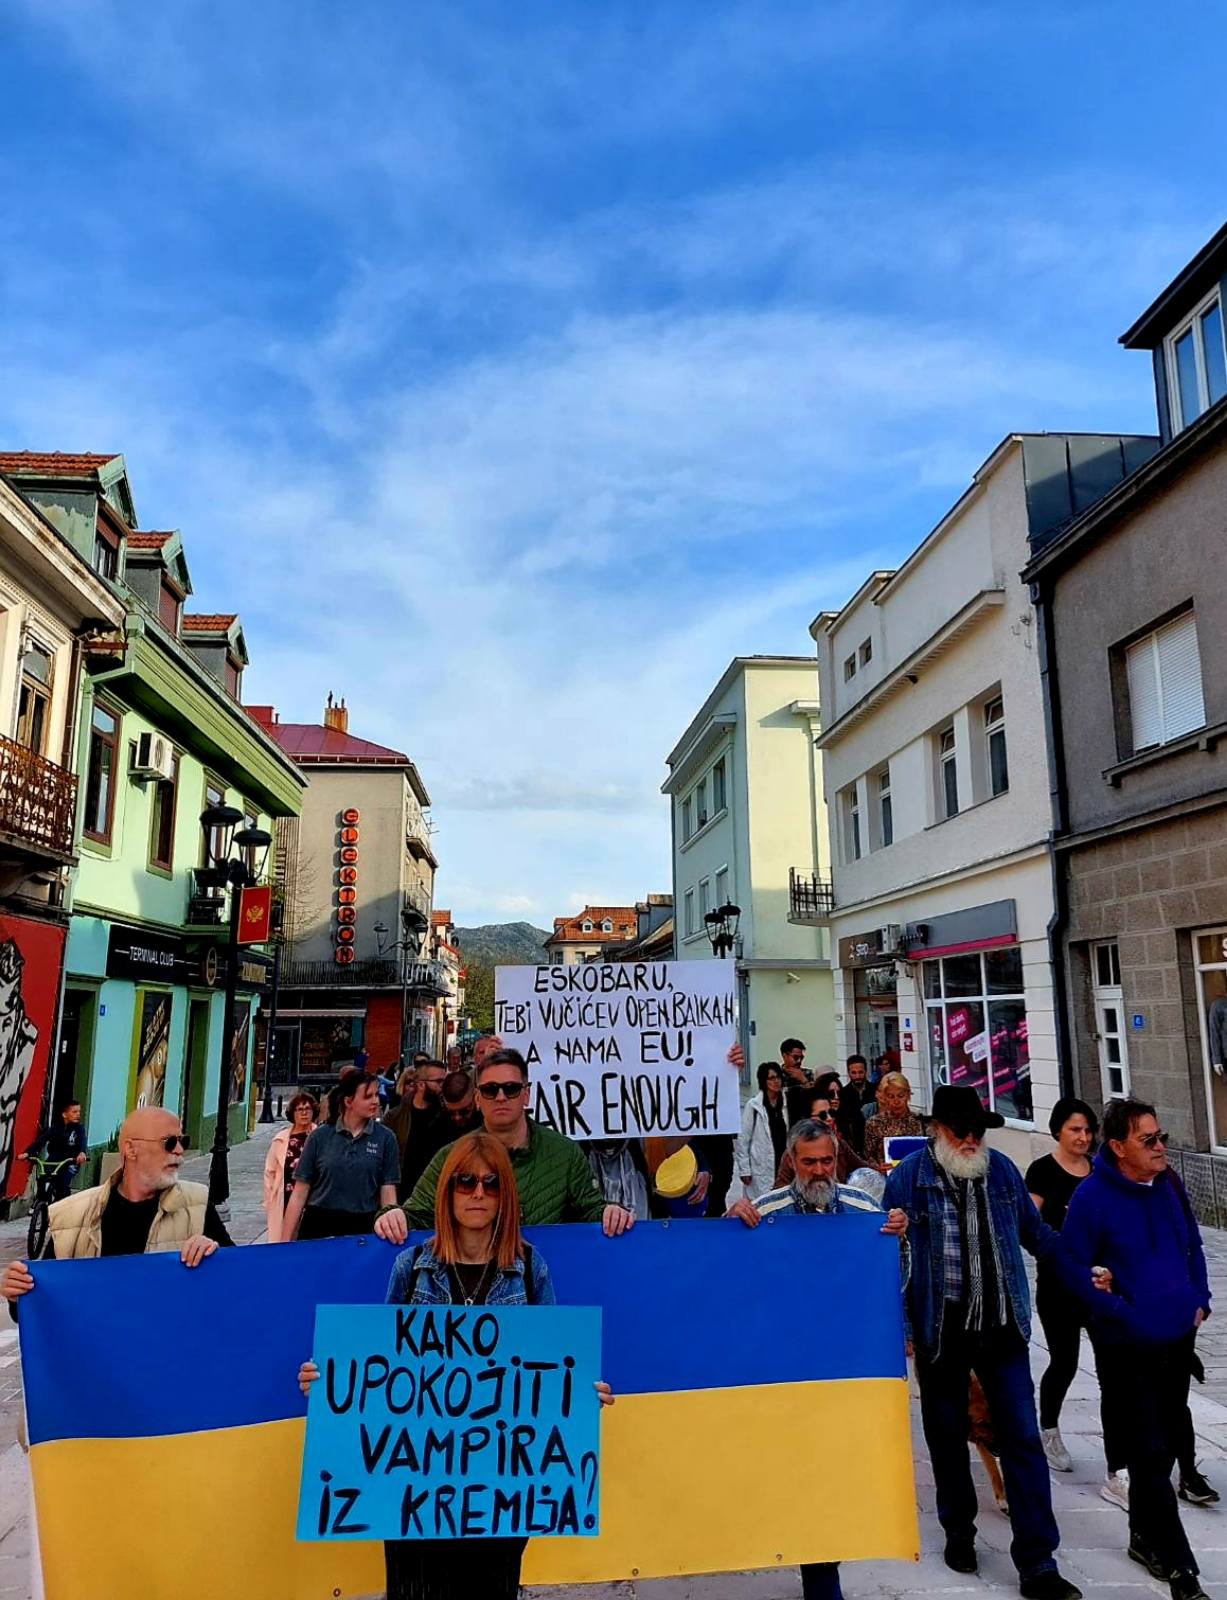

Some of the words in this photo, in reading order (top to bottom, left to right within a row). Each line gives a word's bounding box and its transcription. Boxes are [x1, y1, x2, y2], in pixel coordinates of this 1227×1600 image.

[159, 951, 174, 966] CLUB
[534, 964, 674, 993] ESKOBARU,
[625, 995, 670, 1028] OPEN
[526, 1040, 542, 1064] A
[554, 1035, 622, 1064] NAMA
[640, 1031, 694, 1067] EU!
[525, 1074, 592, 1137] AIR
[601, 1072, 719, 1134] ENOUGH
[396, 1308, 499, 1359] KAKO
